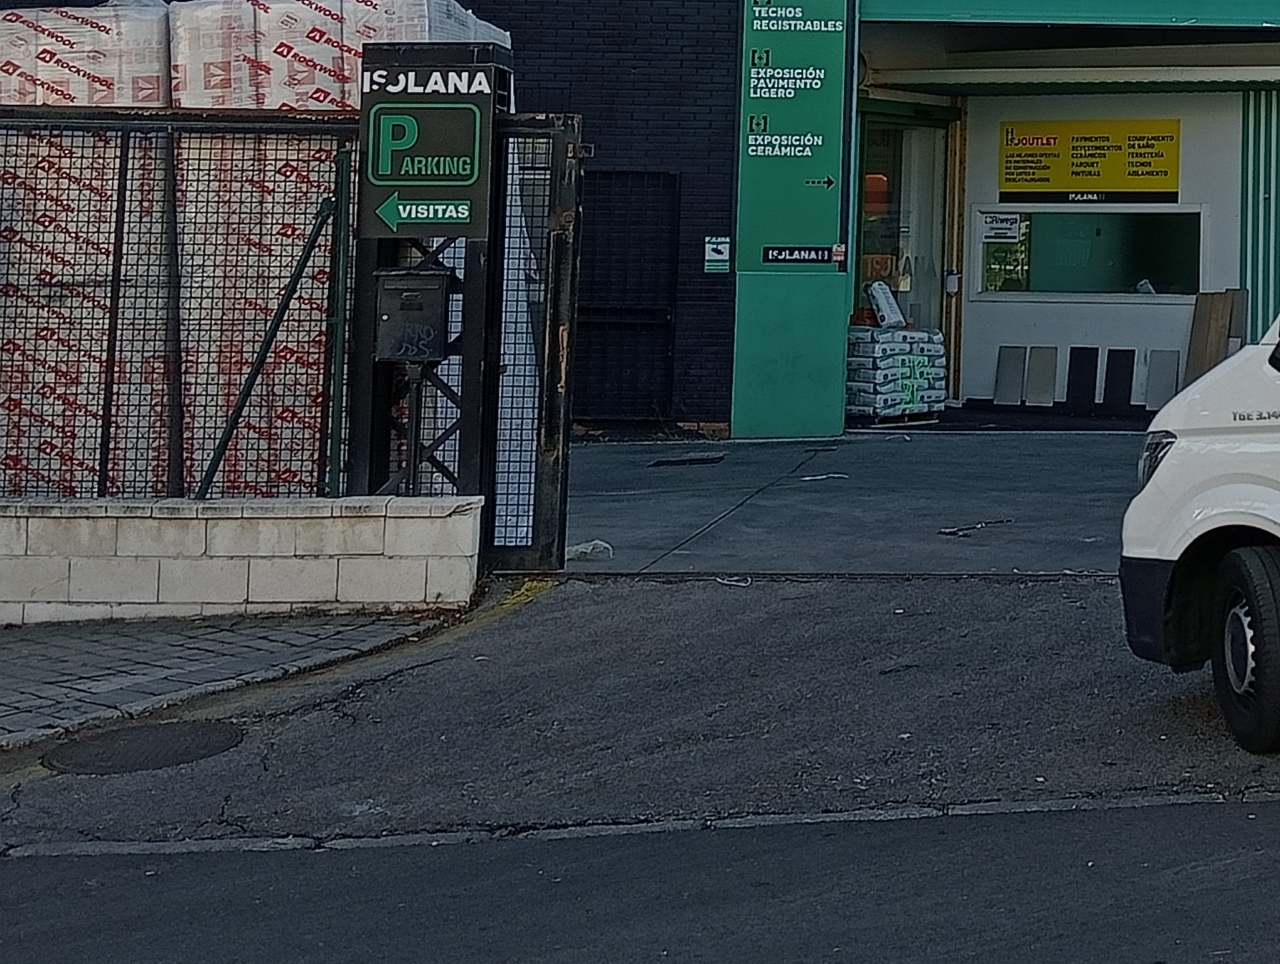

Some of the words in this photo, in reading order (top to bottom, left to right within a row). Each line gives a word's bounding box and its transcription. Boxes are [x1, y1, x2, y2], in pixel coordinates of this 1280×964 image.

[753, 7, 802, 17] TECHOS
[753, 20, 843, 31] REGISTRABLES
[19, 19, 77, 49] ROCKWOOL
[54, 58, 115, 89] ROCKWOOL
[750, 67, 824, 78] EXPOSICIÓN
[17, 71, 77, 103] ROCKWOOL
[362, 70, 492, 93] ISOLANA
[750, 79, 821, 88] PAVIMENTO
[750, 89, 794, 98] LIGERO
[378, 115, 471, 175] PARKING
[748, 134, 822, 145] EXPOSICIÓN
[748, 145, 811, 156] CERÁMICA
[398, 205, 469, 218] VISITAS
